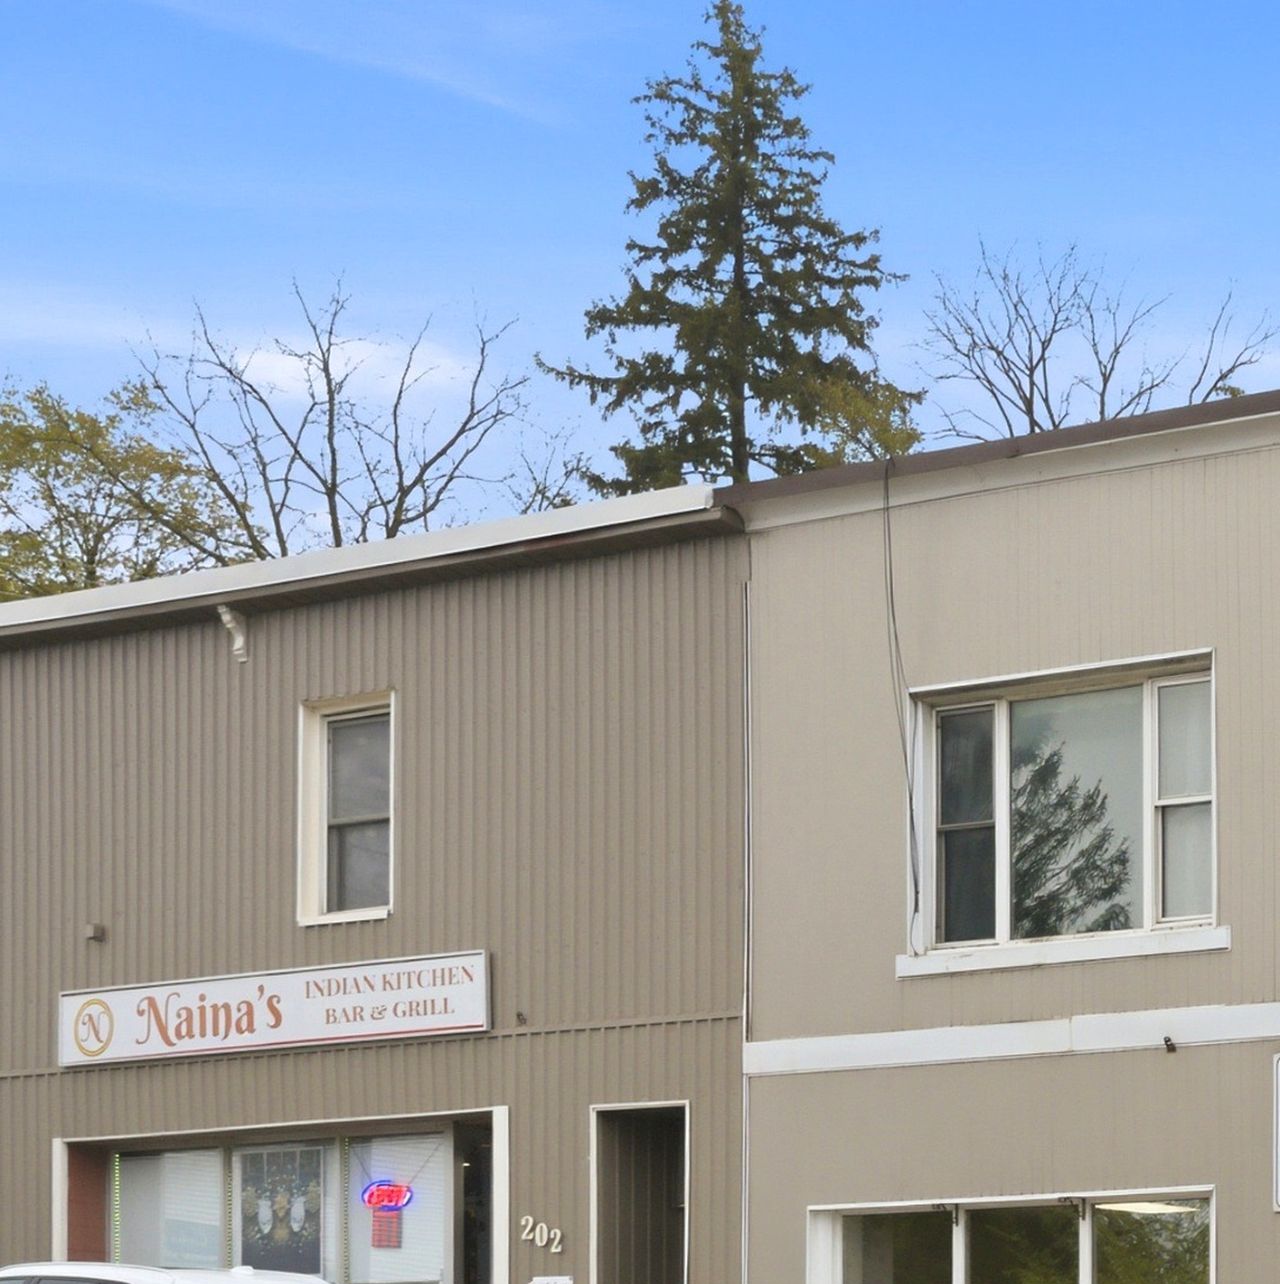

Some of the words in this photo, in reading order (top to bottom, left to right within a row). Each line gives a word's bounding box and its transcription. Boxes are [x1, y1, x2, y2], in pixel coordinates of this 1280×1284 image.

[305, 974, 375, 999] INDIAN
[382, 964, 475, 992] KITCHEN
[136, 984, 283, 1047] Naina's
[325, 1005, 364, 1025] BAR
[370, 1004, 387, 1020] &
[392, 997, 455, 1018] GRILL
[520, 1215, 562, 1253] 202
